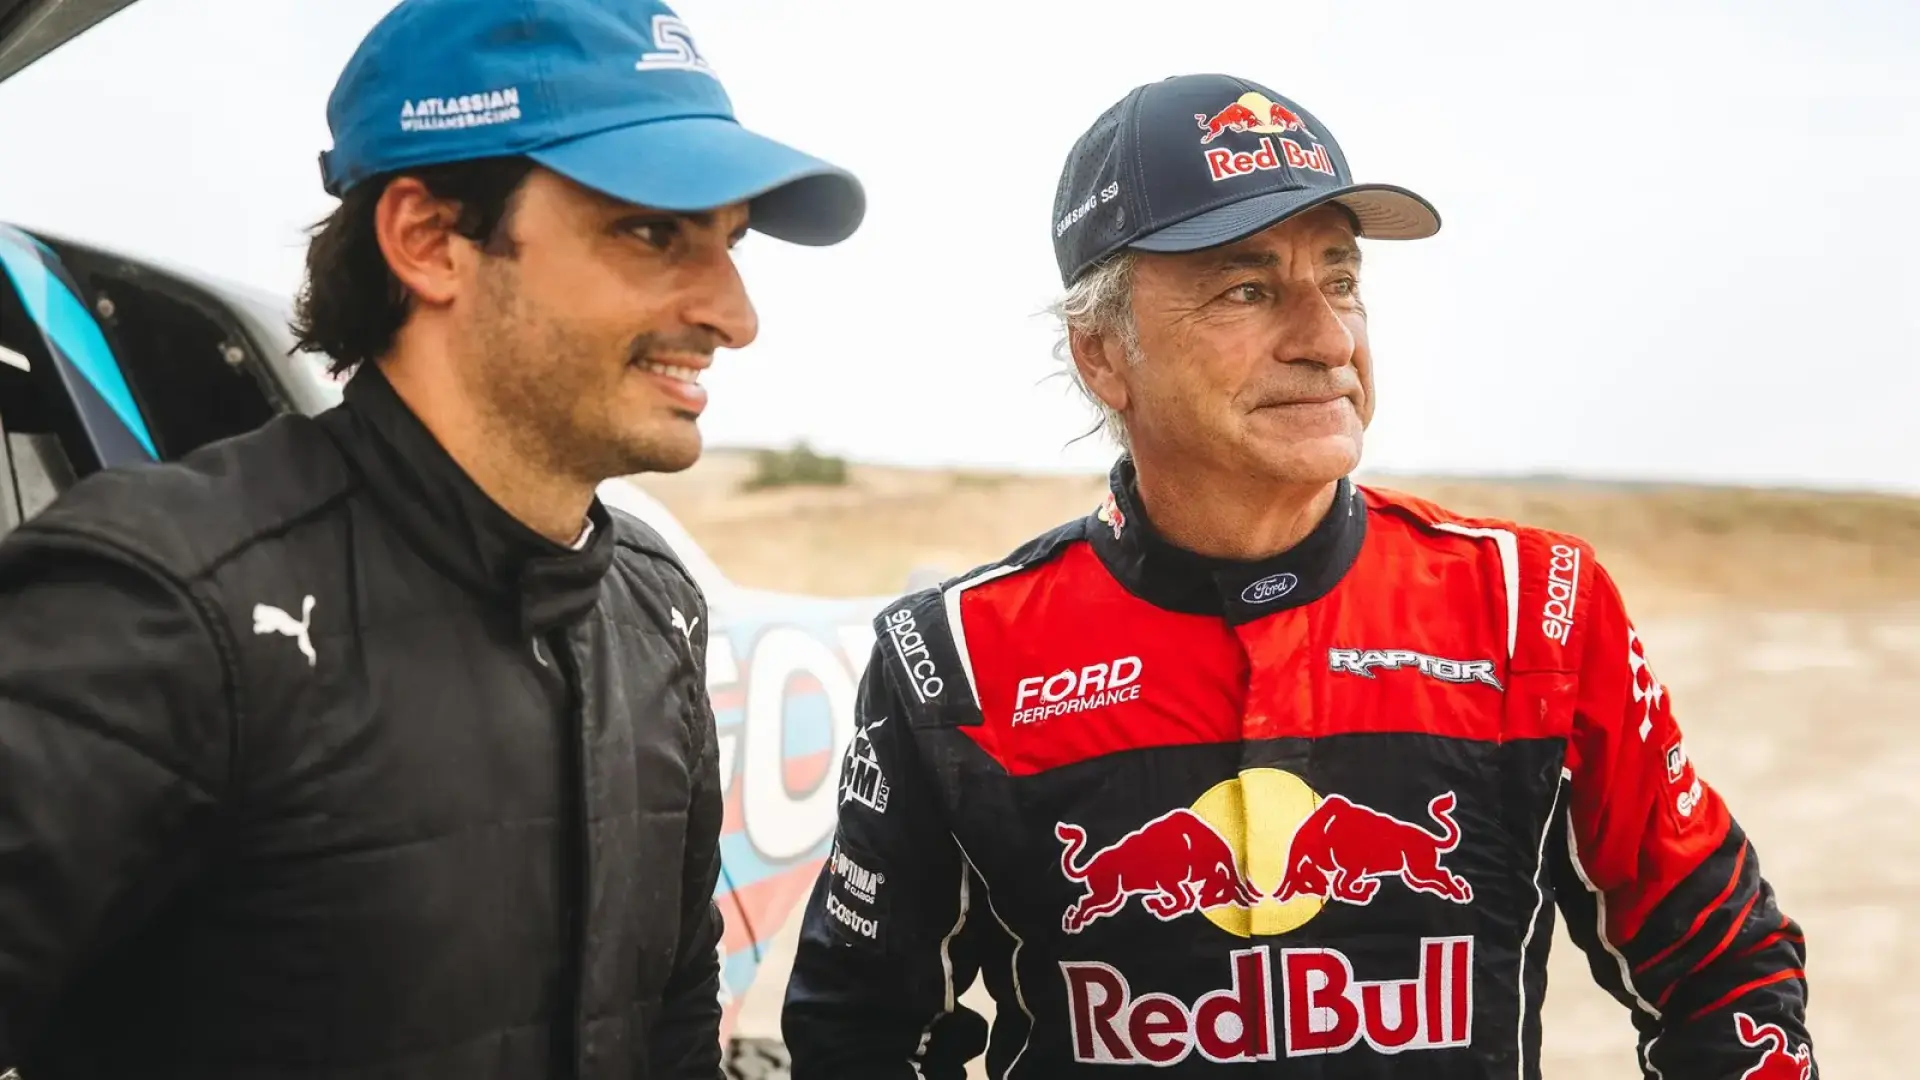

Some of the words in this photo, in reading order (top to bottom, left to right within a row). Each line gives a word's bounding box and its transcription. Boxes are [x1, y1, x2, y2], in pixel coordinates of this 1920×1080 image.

[635, 13, 719, 80] 5
[415, 87, 519, 116] ATLASSIAN
[1204, 137, 1280, 181] Red
[1279, 138, 1336, 176] Bull
[1056, 195, 1097, 237] SAMSUNG
[1101, 181, 1119, 203] SSD
[1254, 577, 1288, 599] Ford
[1541, 544, 1580, 646] sparco
[885, 609, 943, 703] sparco
[1015, 656, 1143, 710] FORD
[1329, 647, 1504, 692] RAPTOR
[1011, 685, 1141, 727] PERFORMANCE
[1059, 947, 1276, 1066] Red
[1281, 936, 1474, 1057] Bull
